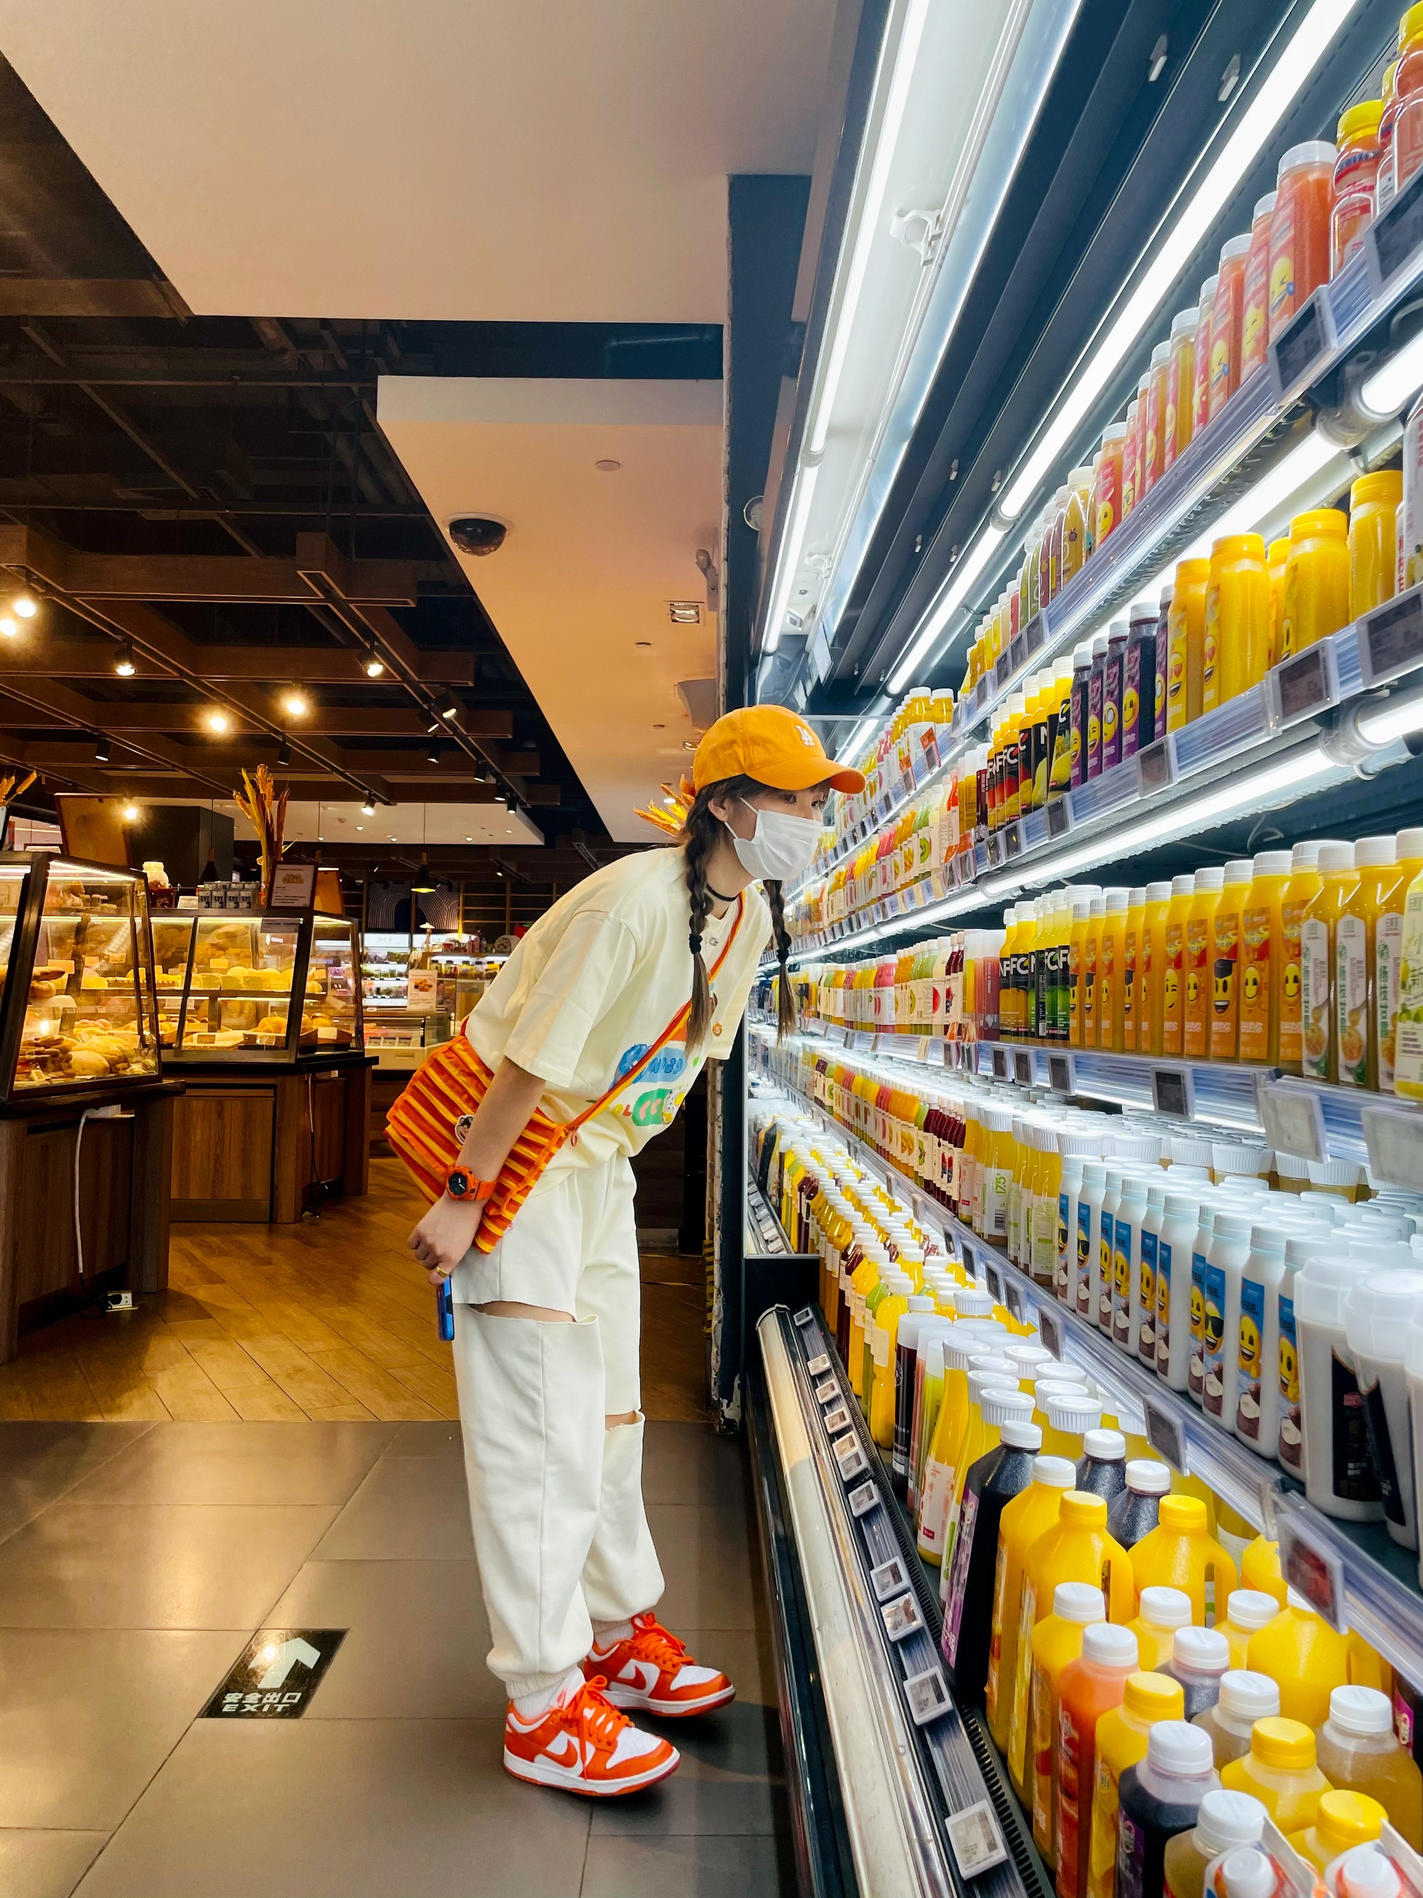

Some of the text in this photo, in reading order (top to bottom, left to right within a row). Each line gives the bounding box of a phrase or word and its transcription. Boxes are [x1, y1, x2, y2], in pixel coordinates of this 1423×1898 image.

[1010, 957, 1030, 975] FC
[222, 1692, 302, 1704] 安全出口
[222, 1704, 291, 1713] EXIT
